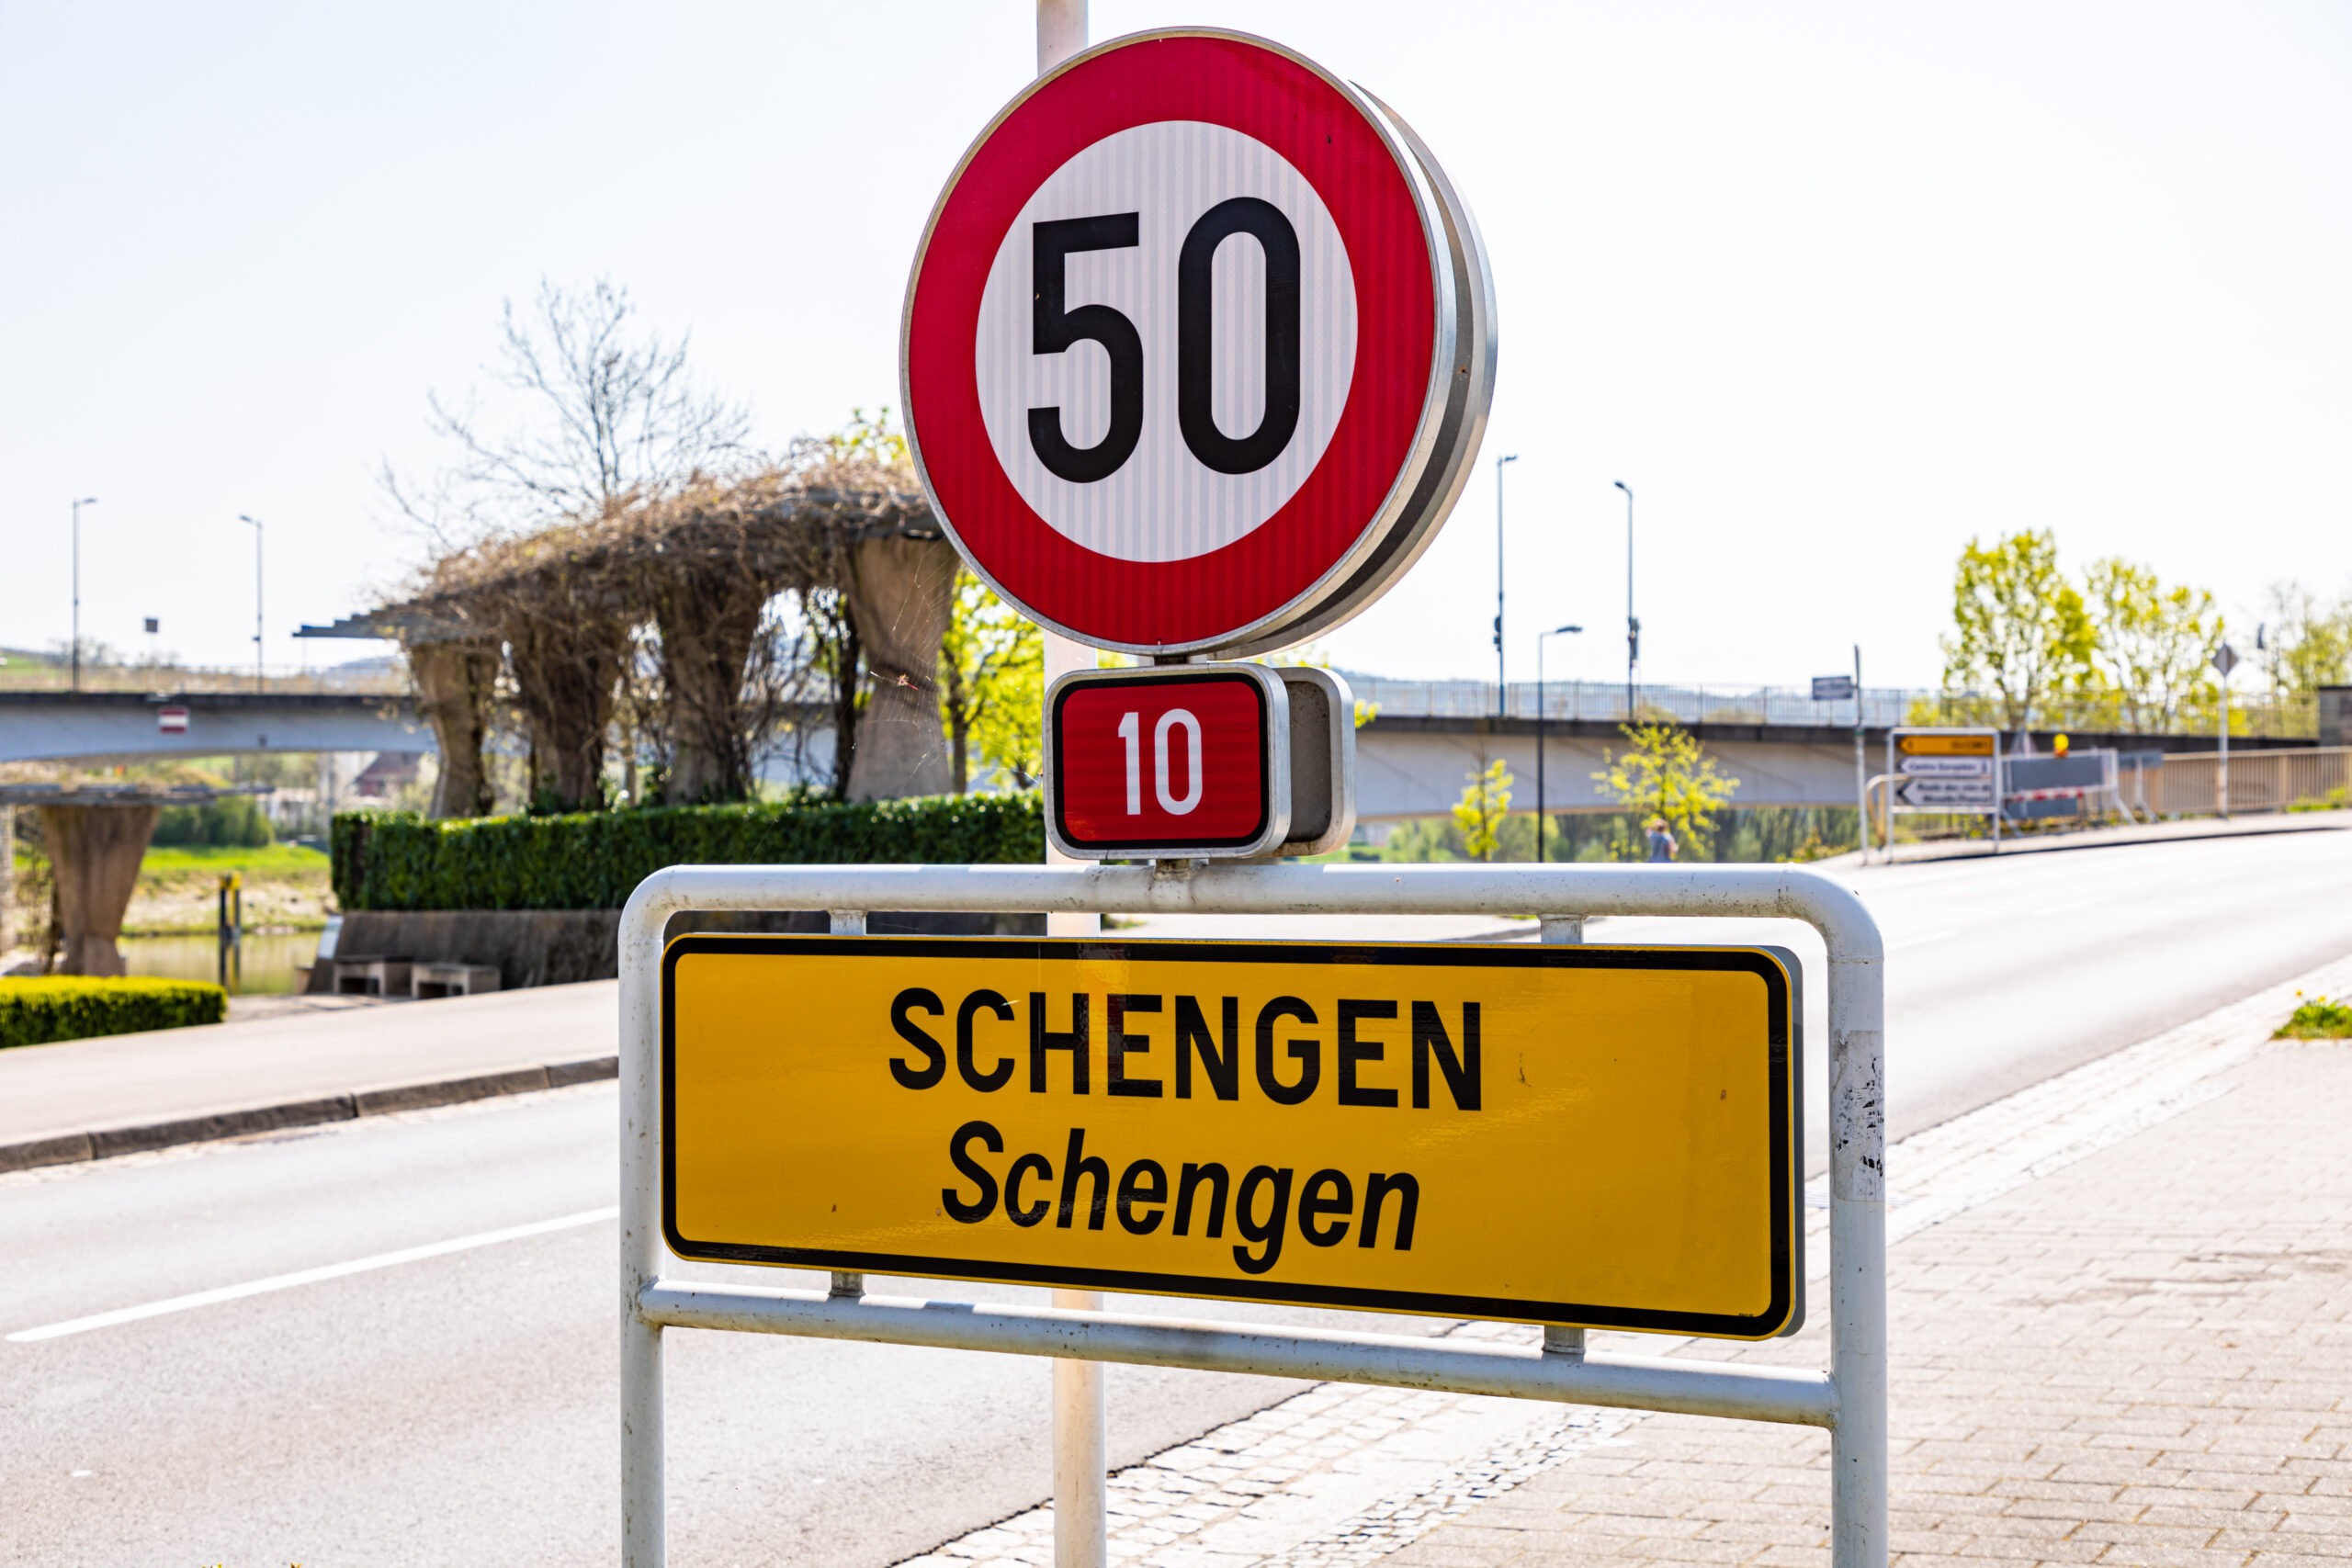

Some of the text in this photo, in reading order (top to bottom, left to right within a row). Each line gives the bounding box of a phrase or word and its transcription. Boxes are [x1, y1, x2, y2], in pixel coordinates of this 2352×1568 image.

[1027, 196, 1301, 484] 50
[1117, 708, 1203, 816] 10
[888, 987, 1482, 1111] SCHENGEN
[941, 1120, 1420, 1275] Schengen
